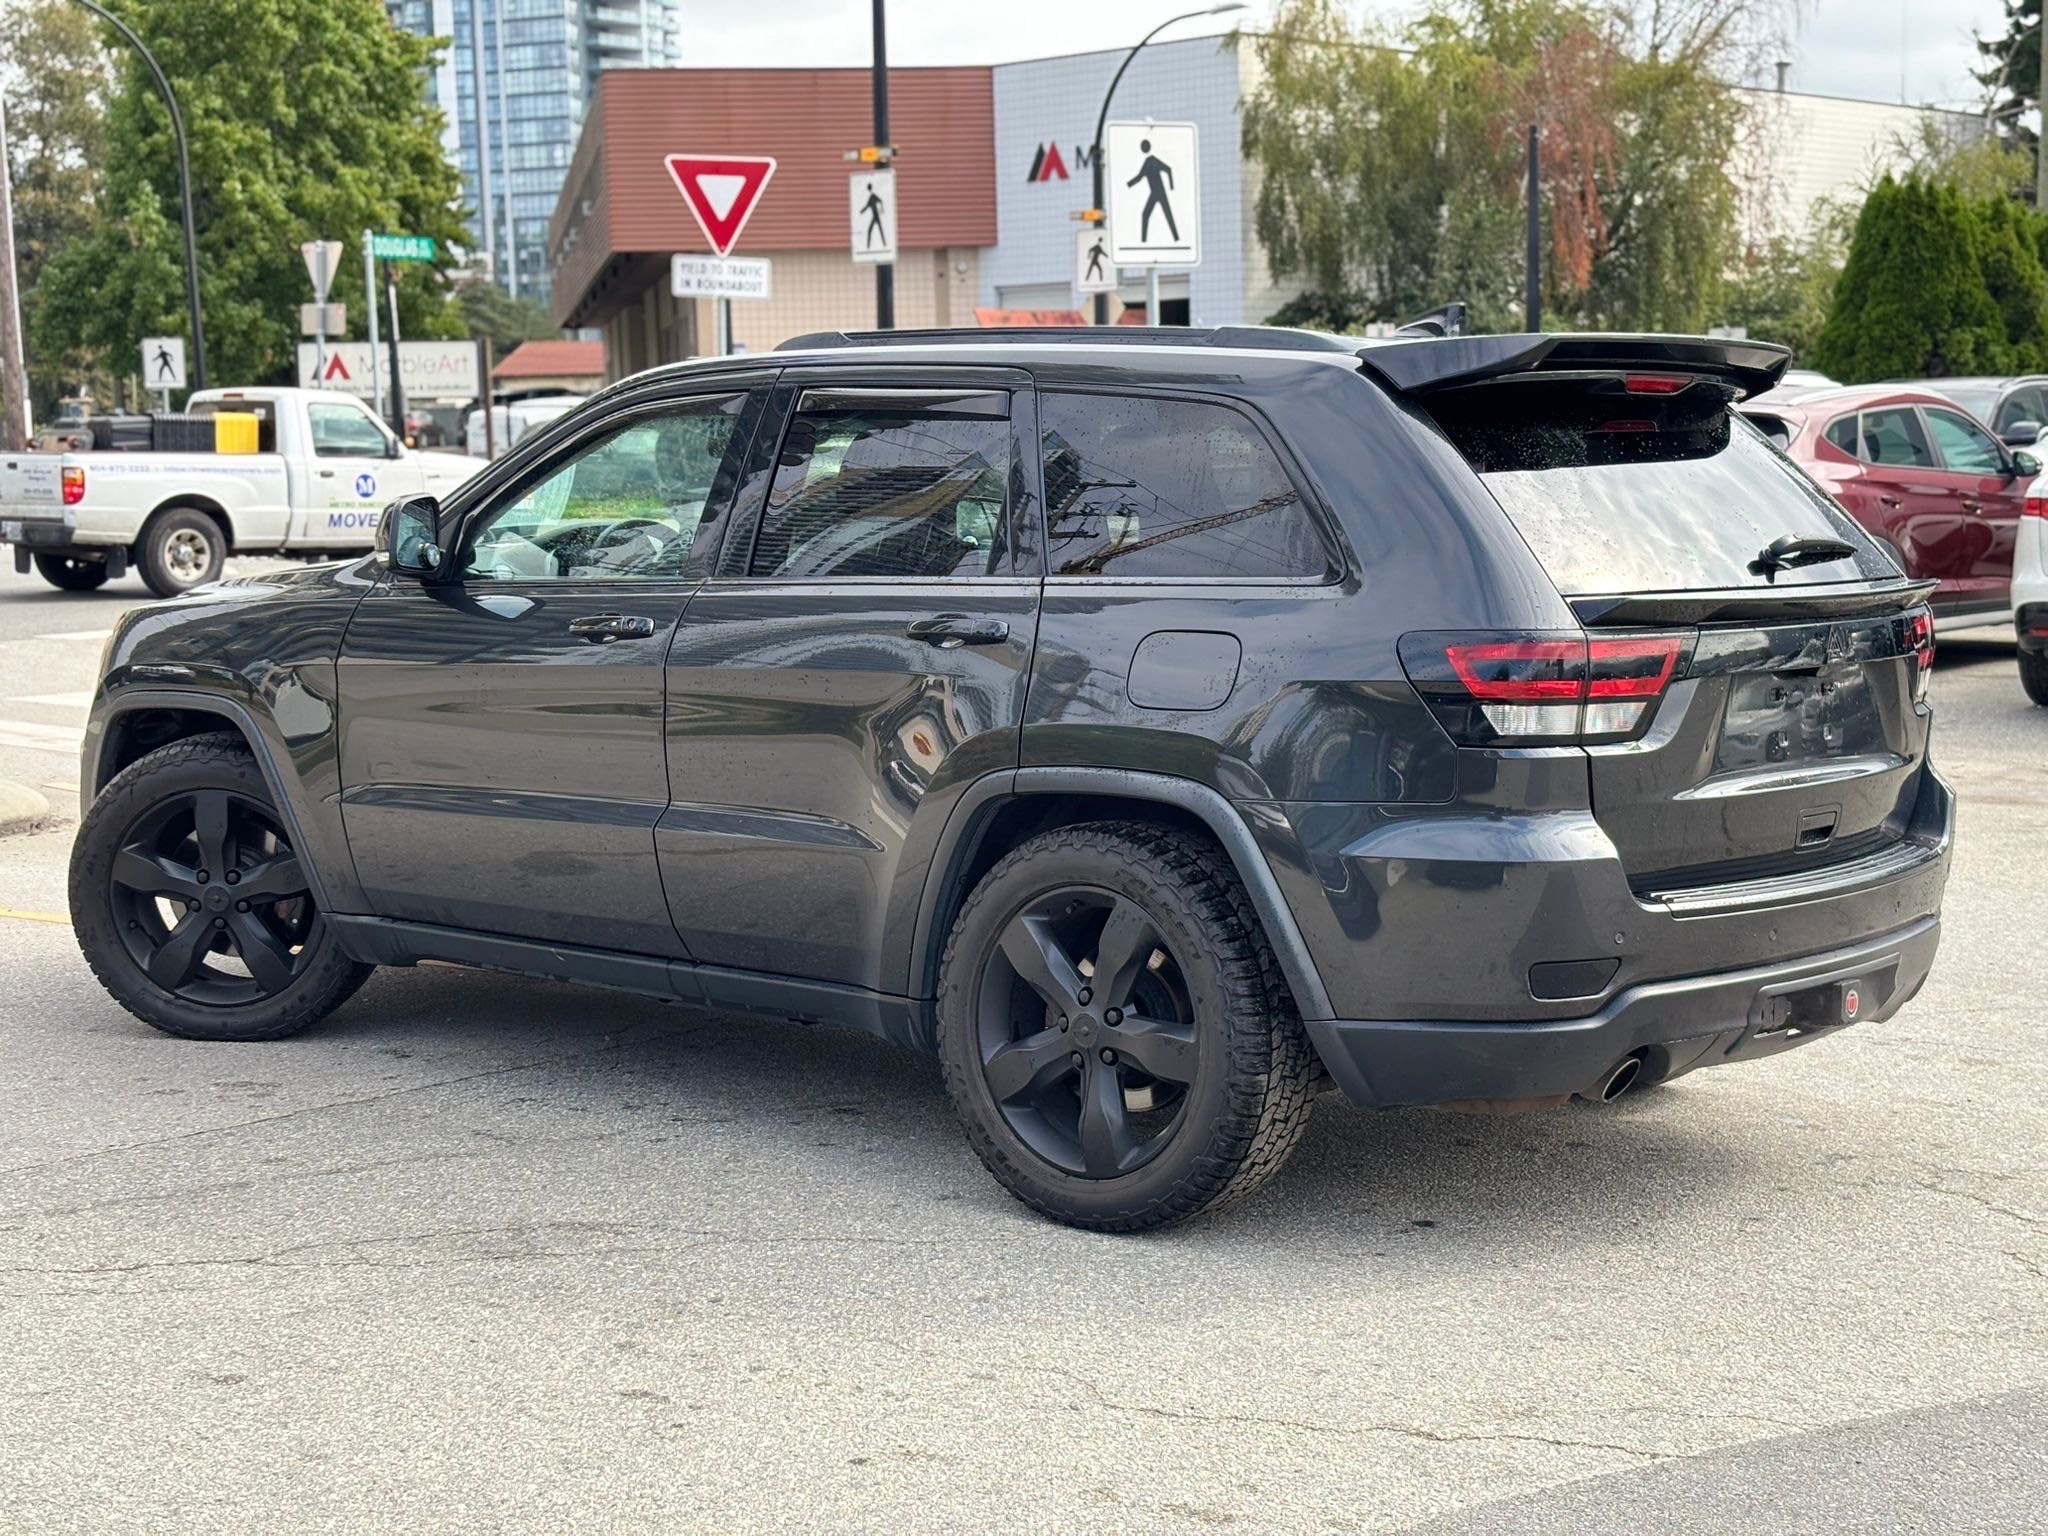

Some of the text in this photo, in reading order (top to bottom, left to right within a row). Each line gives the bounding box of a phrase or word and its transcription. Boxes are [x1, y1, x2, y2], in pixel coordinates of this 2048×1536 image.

[680, 263, 763, 278] YIELD TO TRAFFIC
[681, 278, 763, 293] IN ROUNDABOUT
[359, 354, 467, 376] MableArt
